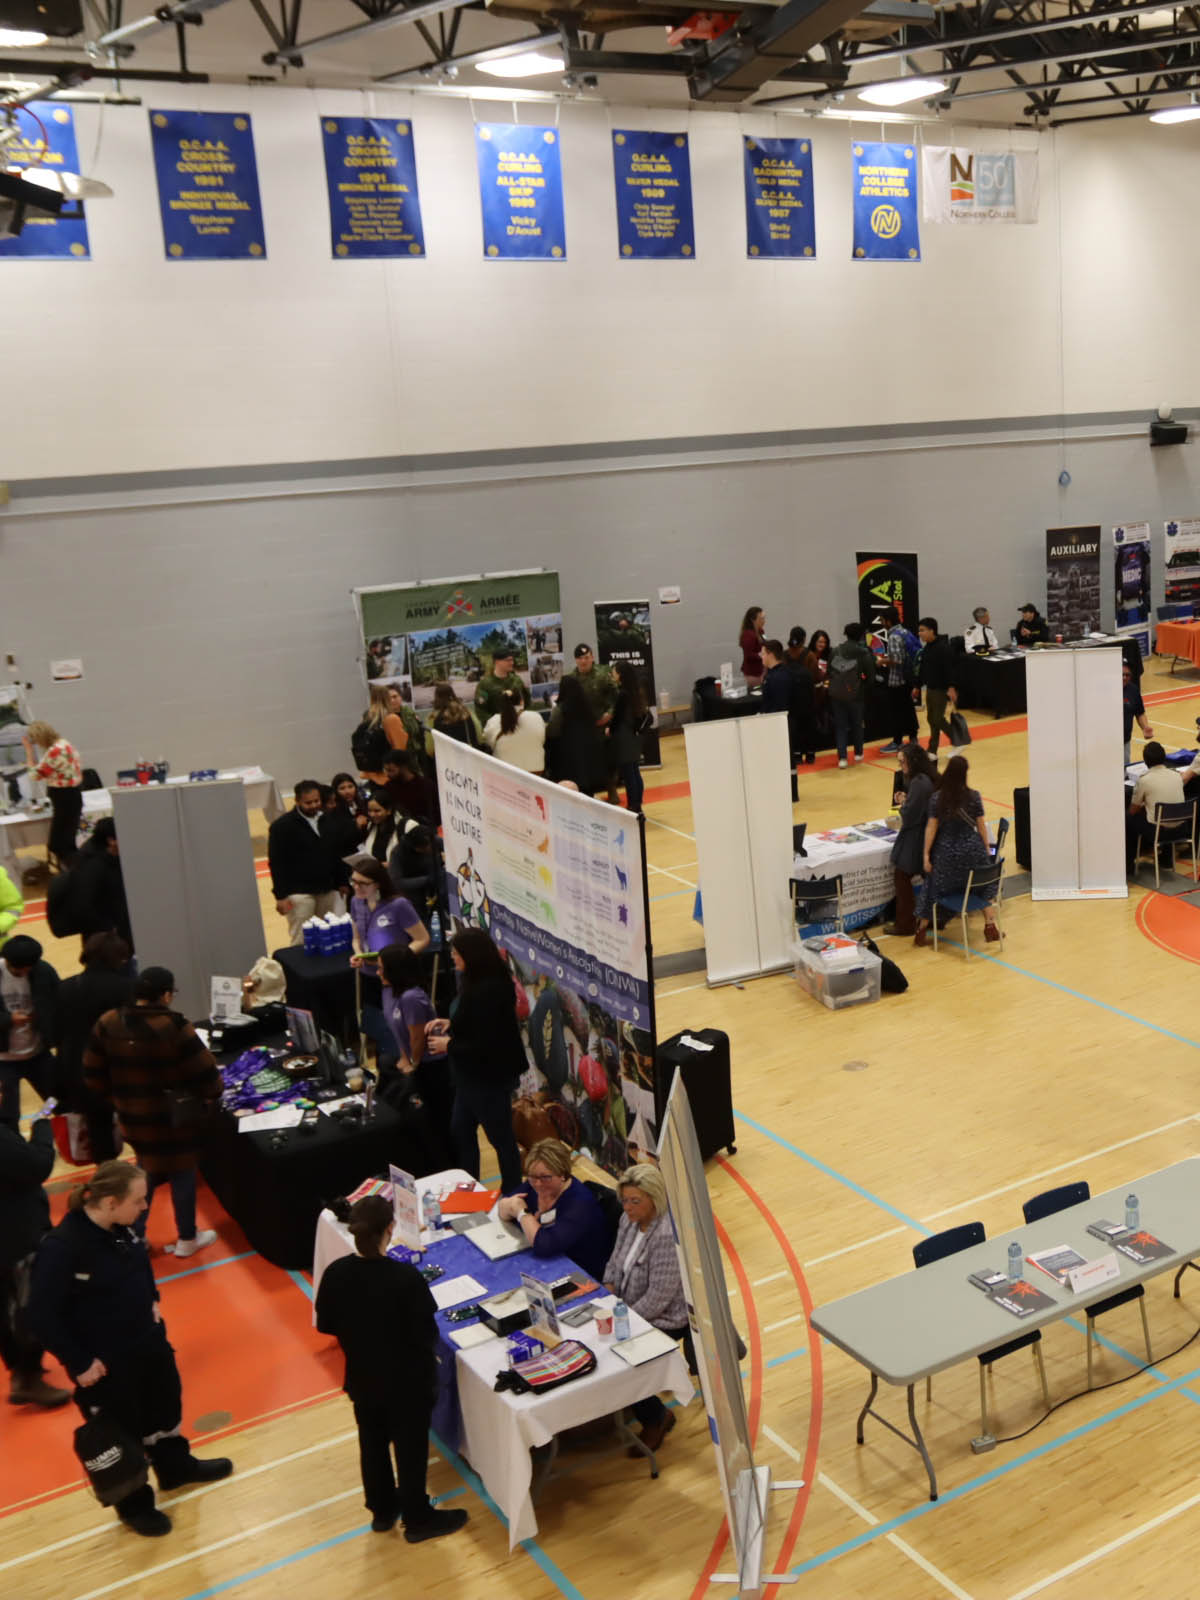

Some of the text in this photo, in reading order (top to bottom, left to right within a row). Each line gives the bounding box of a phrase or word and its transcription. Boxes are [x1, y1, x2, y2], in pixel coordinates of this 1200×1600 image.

[863, 176, 905, 187] COLLEGE
[860, 187, 910, 197] ATHLETICS
[1050, 543, 1098, 556] AUXILIARY
[480, 594, 521, 609] ARMÉE
[406, 607, 440, 619] ARMY
[610, 652, 630, 660] THIS
[445, 767, 479, 797] GROWTH
